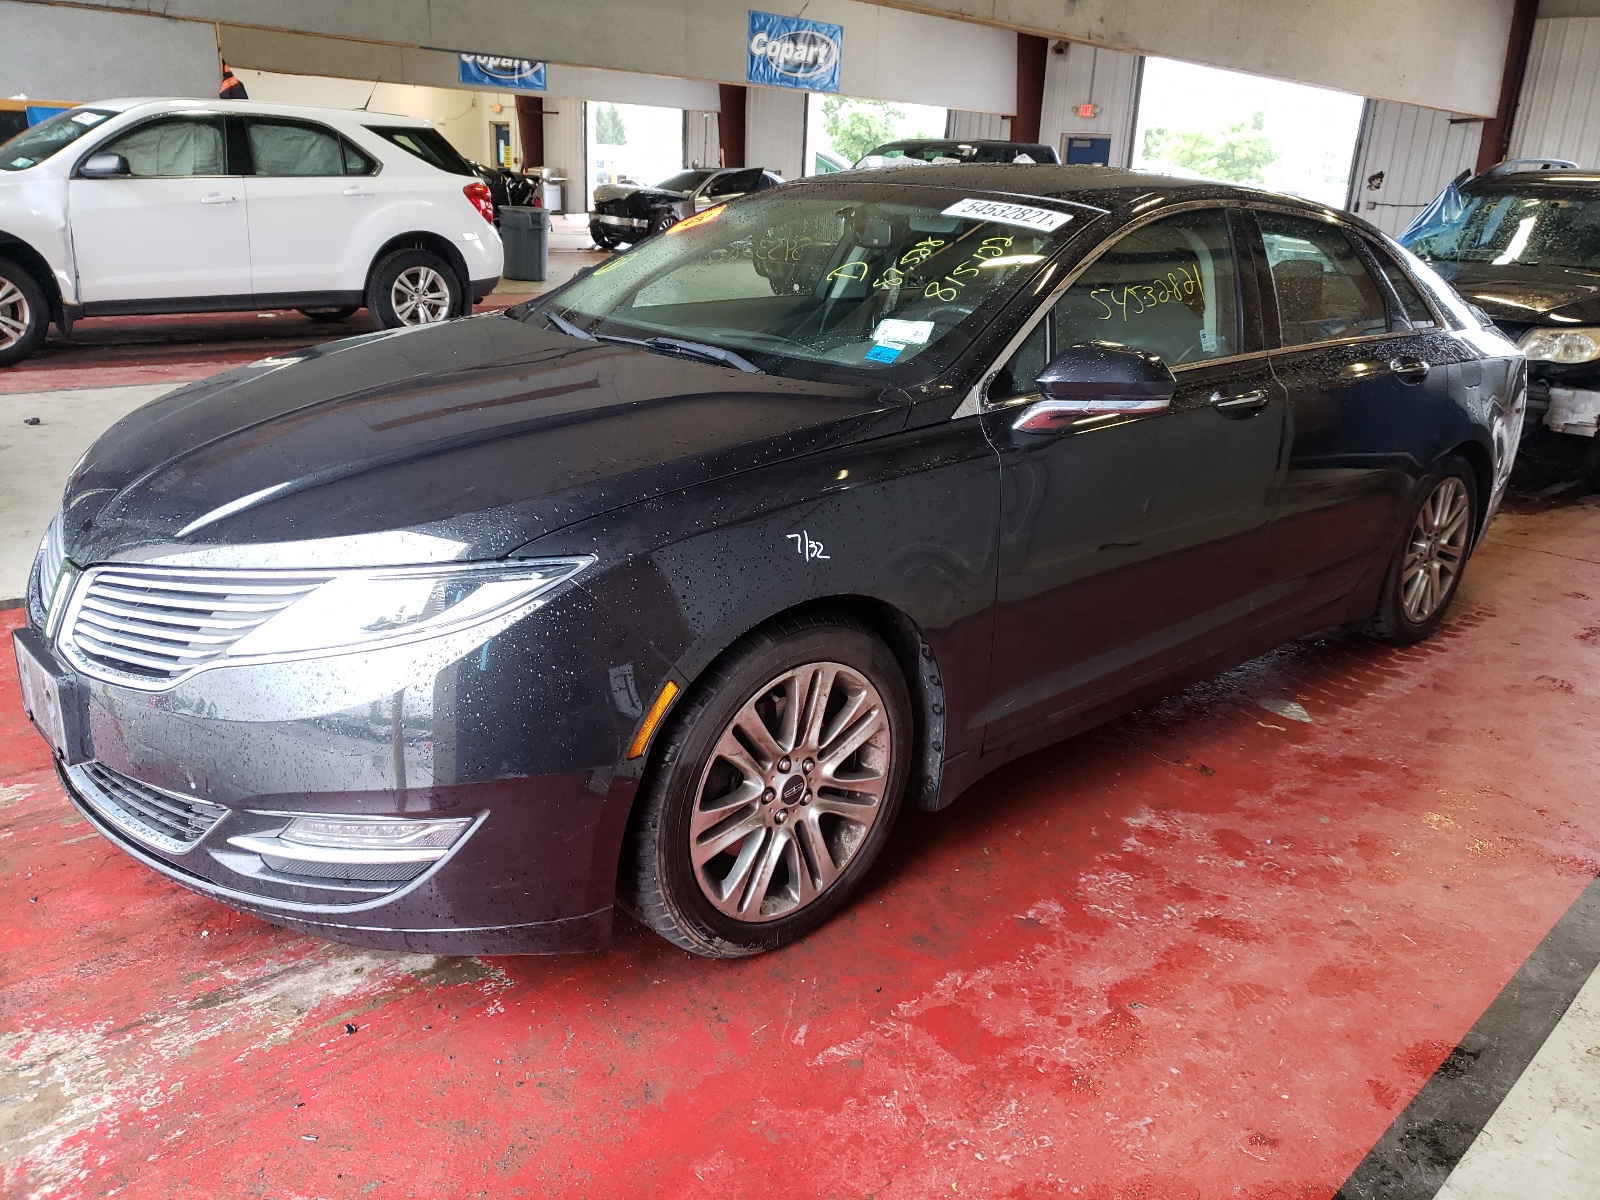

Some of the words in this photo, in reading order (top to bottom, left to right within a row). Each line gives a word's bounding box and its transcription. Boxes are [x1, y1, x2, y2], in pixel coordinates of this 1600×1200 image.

[751, 32, 828, 67] Copart
[962, 201, 1053, 225] 54532821
[1090, 264, 1206, 322] 54532821
[786, 529, 831, 562] 7/32
